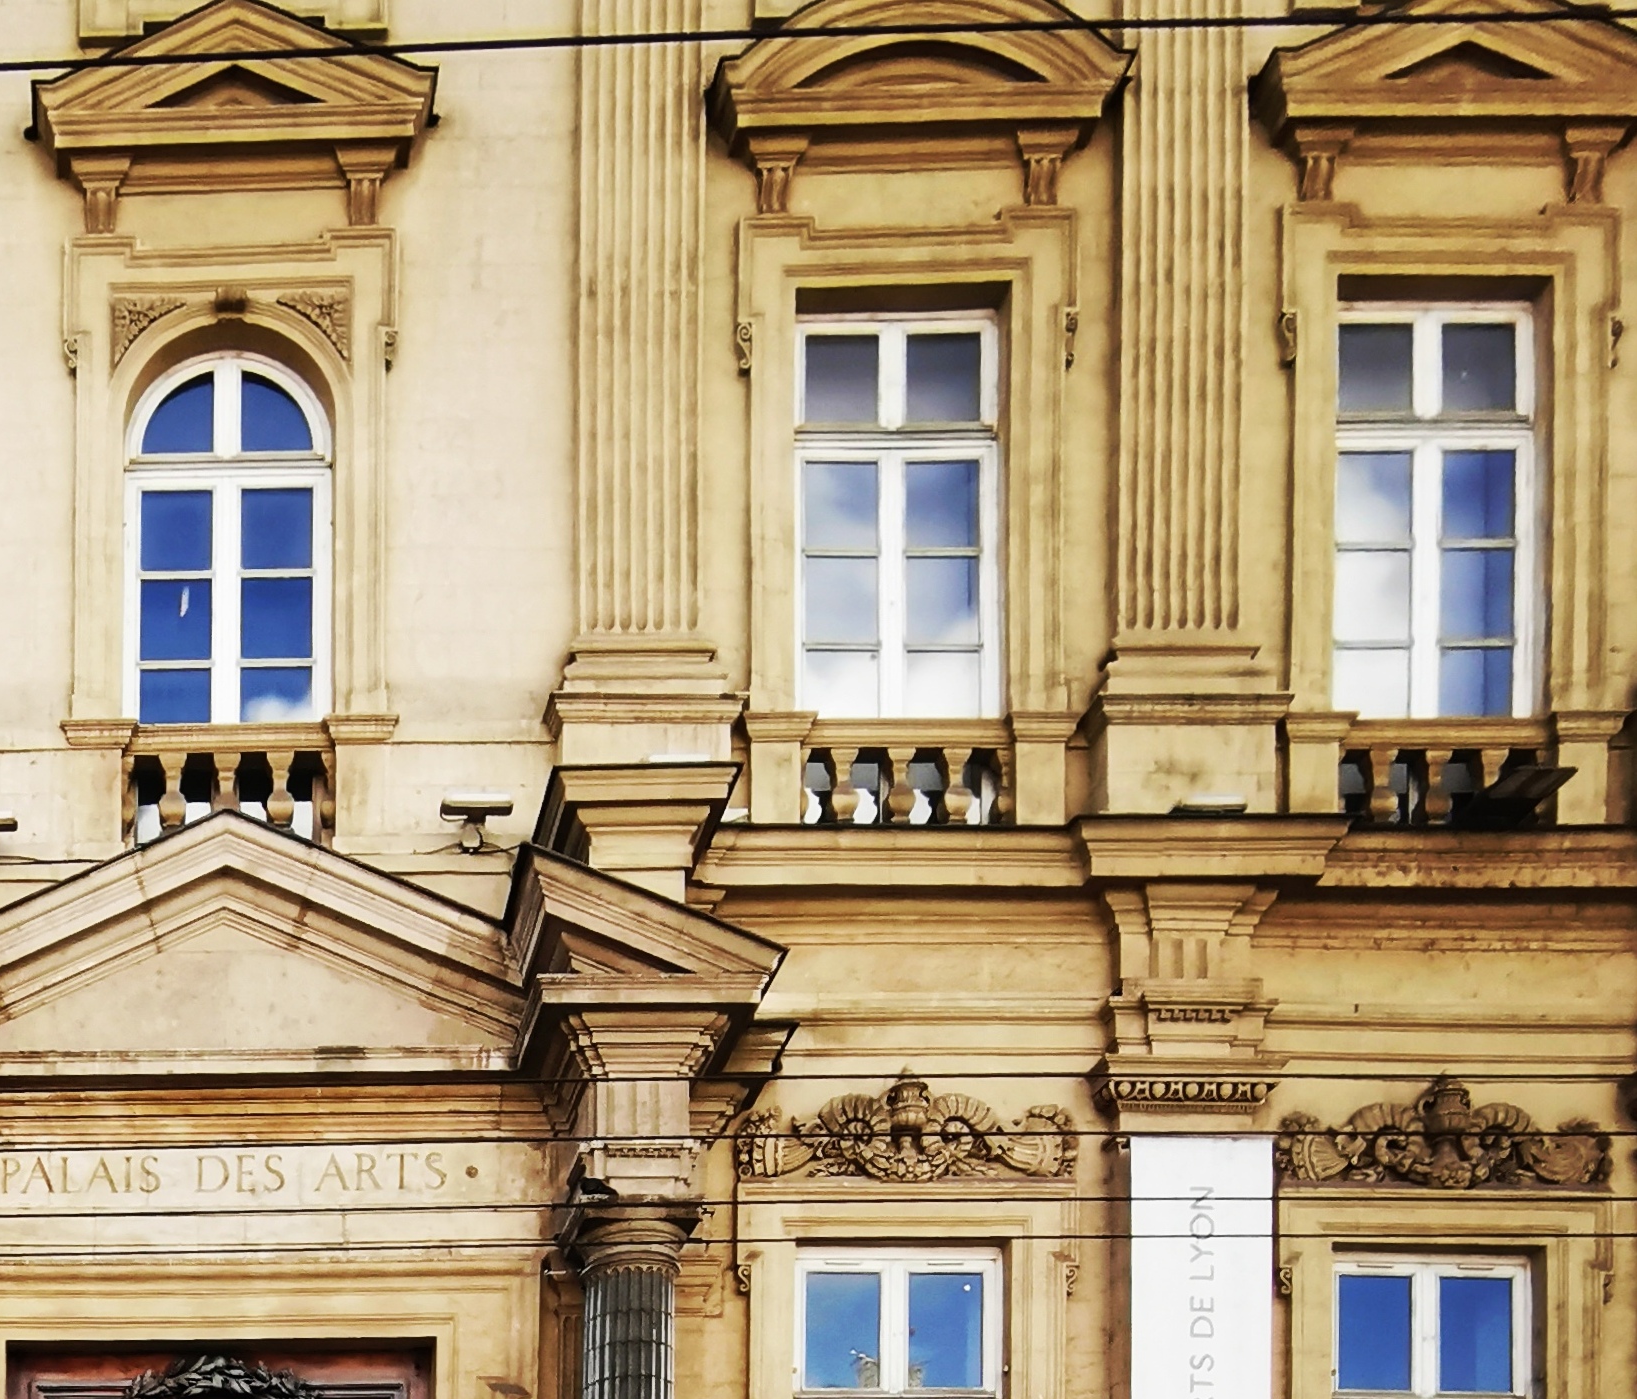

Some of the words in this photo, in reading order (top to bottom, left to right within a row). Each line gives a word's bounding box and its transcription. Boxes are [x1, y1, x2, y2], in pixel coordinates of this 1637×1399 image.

[0, 1155, 162, 1195] PALAIS
[194, 1153, 286, 1195] DES
[313, 1151, 449, 1193] ARTS
[1189, 1186, 1215, 1281] LYON
[1190, 1296, 1215, 1339] DE
